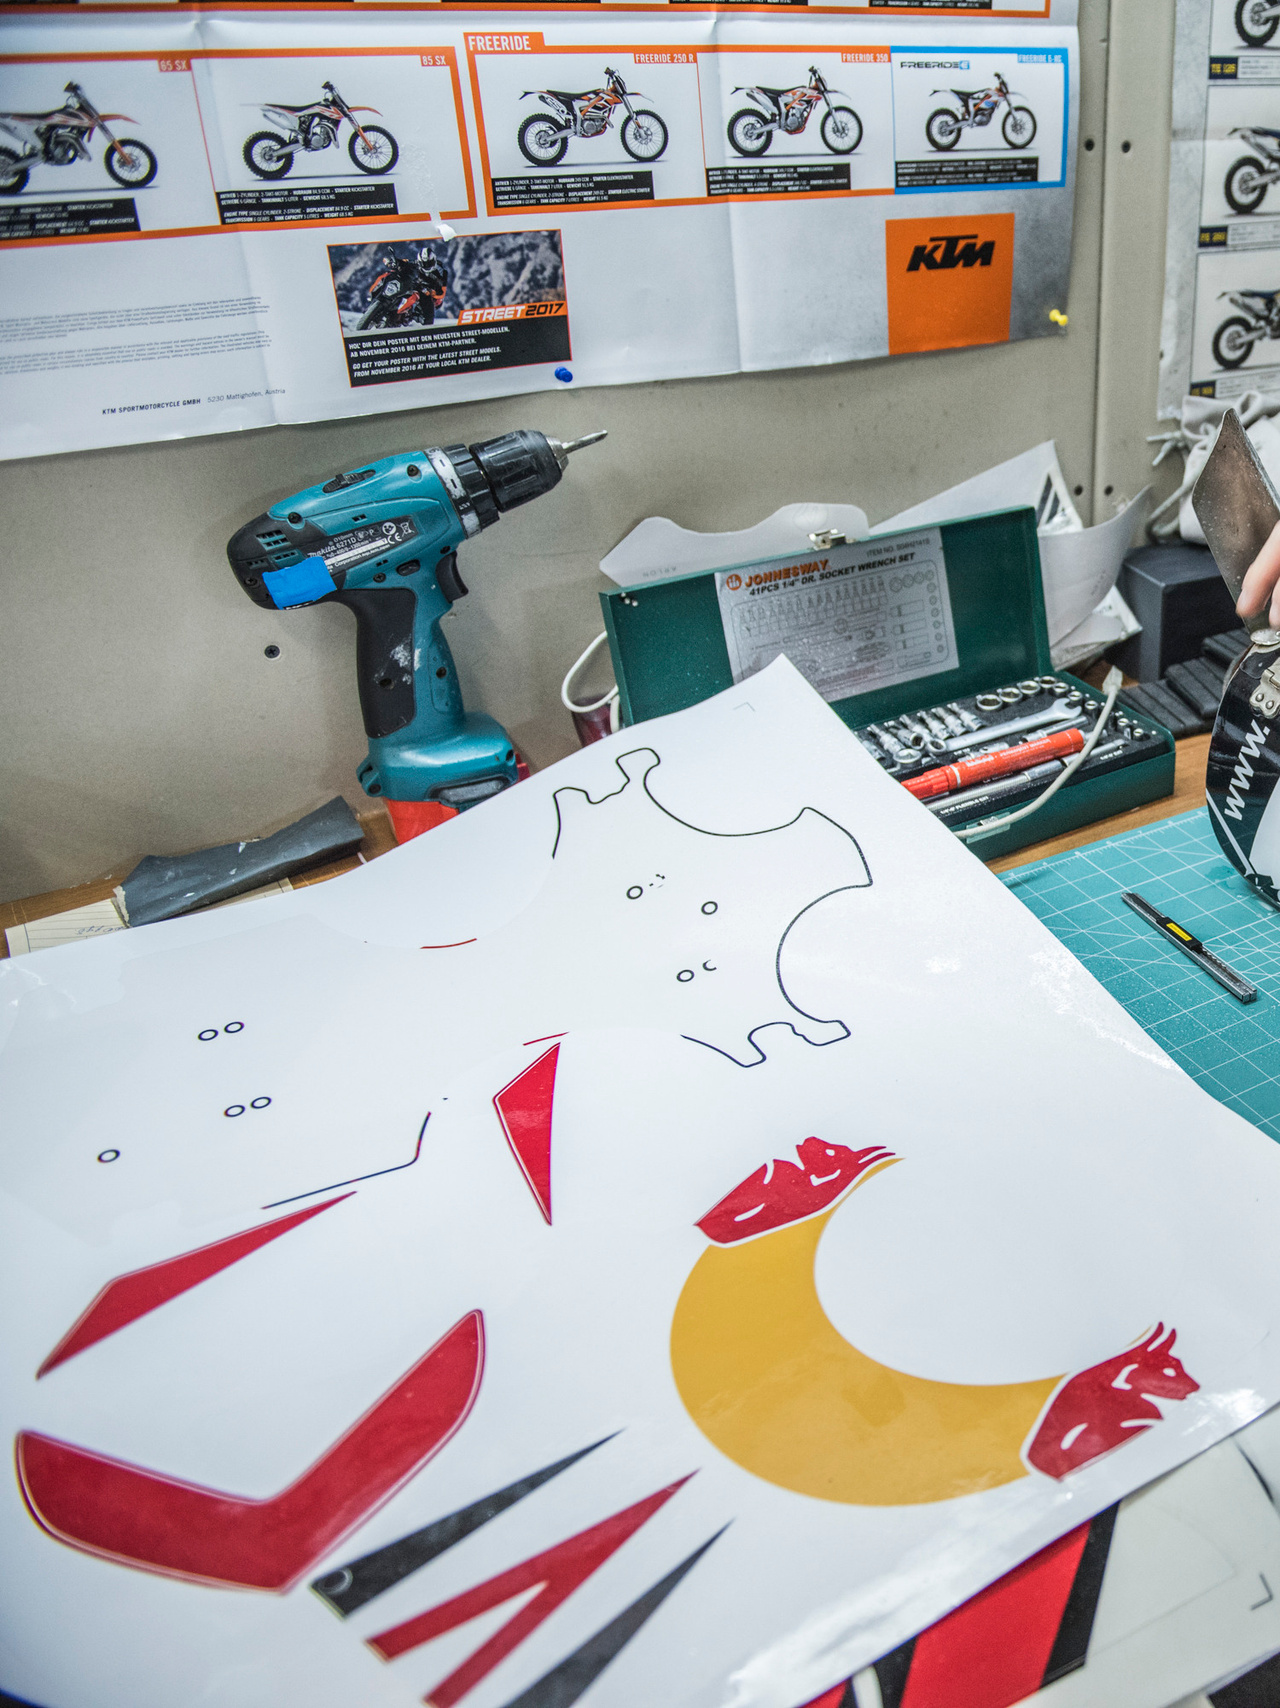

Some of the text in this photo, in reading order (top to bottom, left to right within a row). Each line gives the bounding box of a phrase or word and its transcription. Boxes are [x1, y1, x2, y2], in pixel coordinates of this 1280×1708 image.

[468, 35, 531, 51] FREERIDE
[175, 60, 187, 70] SX
[422, 56, 446, 66] 85 SX
[635, 54, 694, 63] FREERIDE 250 R
[842, 53, 888, 62] FREERIDE 350
[906, 233, 996, 272] KTM
[461, 302, 564, 324] STREET 2017
[387, 337, 409, 345] POSTER
[433, 331, 461, 340] NEUESTEN
[462, 326, 510, 337] STREET-MODELLEN.
[359, 347, 390, 357] NOVEMBER
[416, 342, 438, 351] DEINEM
[438, 338, 477, 348] KTM-PARTNER.
[374, 360, 389, 368] YOUR
[390, 357, 411, 366] POSTER
[412, 355, 427, 363] WITH
[439, 351, 459, 360] LATEST
[459, 349, 478, 357] STREET
[479, 346, 502, 355] MODELS.
[354, 370, 370, 378] FROM
[371, 366, 401, 376] NOVEMBER
[401, 364, 417, 372] 2016
[425, 361, 440, 369] YOUR
[441, 359, 458, 368] LOCAL
[458, 358, 470, 366] KTM
[471, 355, 492, 364] DEALER.
[102, 407, 116, 415] KTM
[118, 400, 180, 413] SPORTMOTORCYCLE
[182, 398, 201, 406] GMBH
[207, 395, 225, 403] 5230
[265, 387, 286, 396] Austria
[336, 536, 356, 549] 6271D
[744, 559, 829, 588] JONNESWAY
[750, 583, 780, 596] 41PCS
[801, 576, 817, 586] DR.
[819, 567, 855, 582] SOCKET
[858, 557, 896, 573] WRENCH
[898, 552, 916, 563] SET
[1223, 719, 1271, 821] www.
